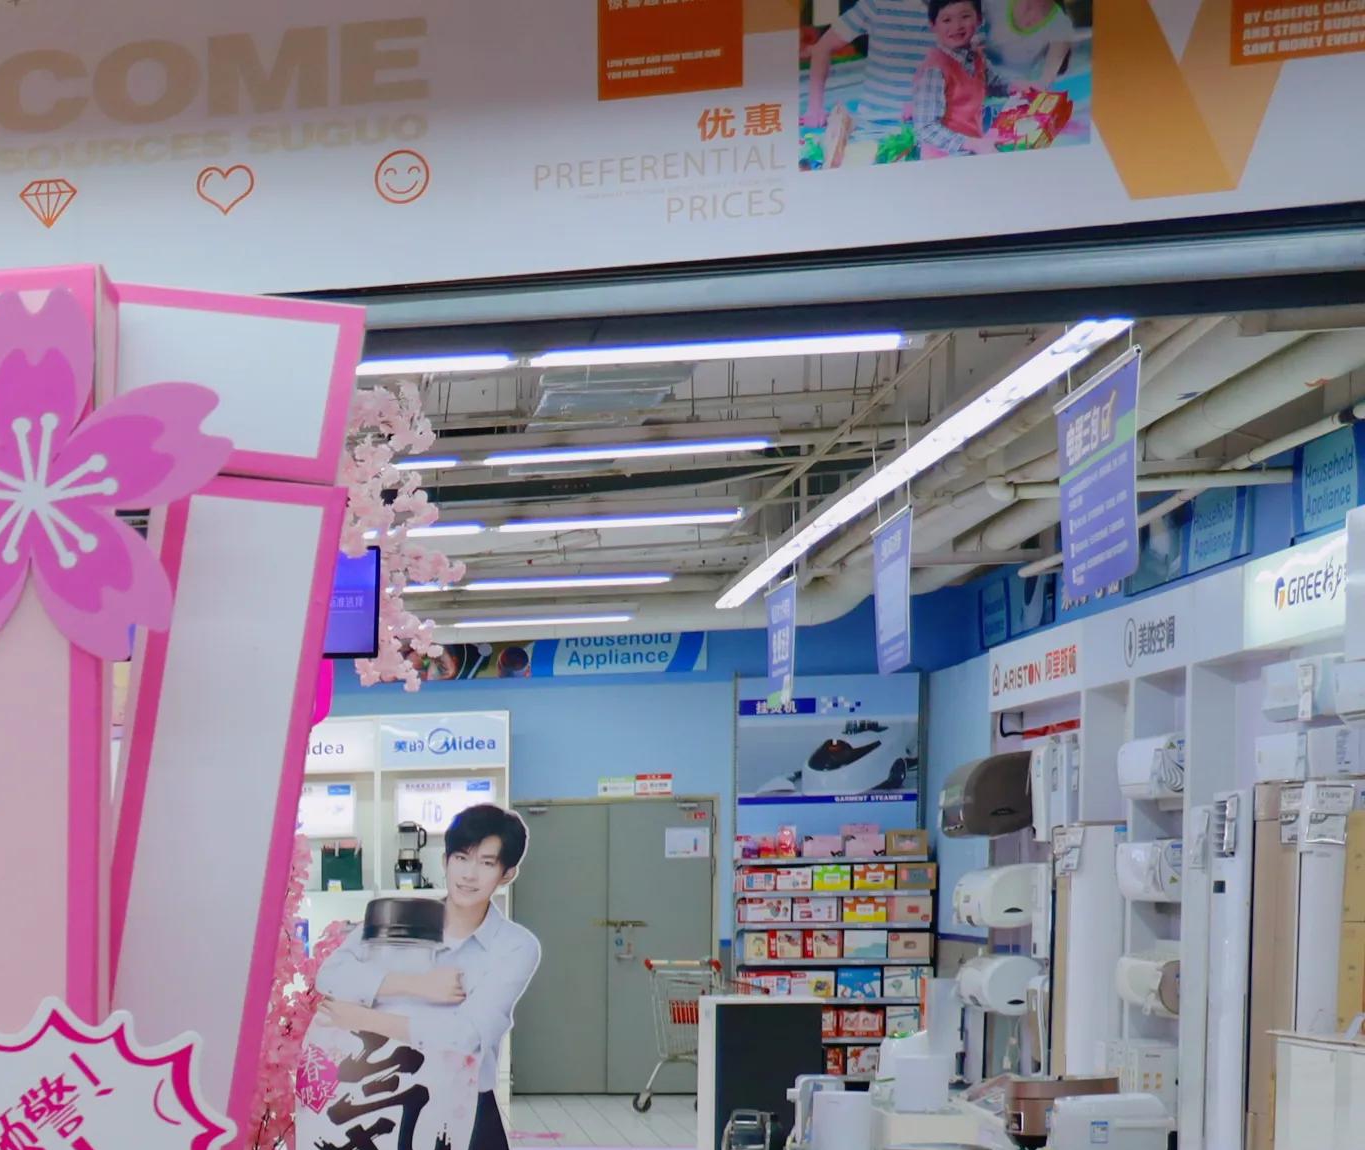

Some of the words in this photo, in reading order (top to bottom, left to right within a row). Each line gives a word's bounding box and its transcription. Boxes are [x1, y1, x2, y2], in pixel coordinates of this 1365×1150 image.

[248, 111, 429, 154] SUGUO
[698, 103, 782, 141] 优惠
[533, 142, 786, 192] PREFERENTIAL
[666, 188, 785, 223] PRICES
[1305, 447, 1355, 488] Household
[1305, 483, 1352, 522] Appliance
[1287, 569, 1322, 605] GREE
[1138, 615, 1176, 657] 美的空调
[567, 648, 670, 669] Appliance
[1003, 661, 1041, 690] ARISTON
[307, 742, 344, 755] idea
[393, 739, 424, 753] 美的
[432, 731, 496, 753] Midea
[301, 1043, 326, 1082] 春
